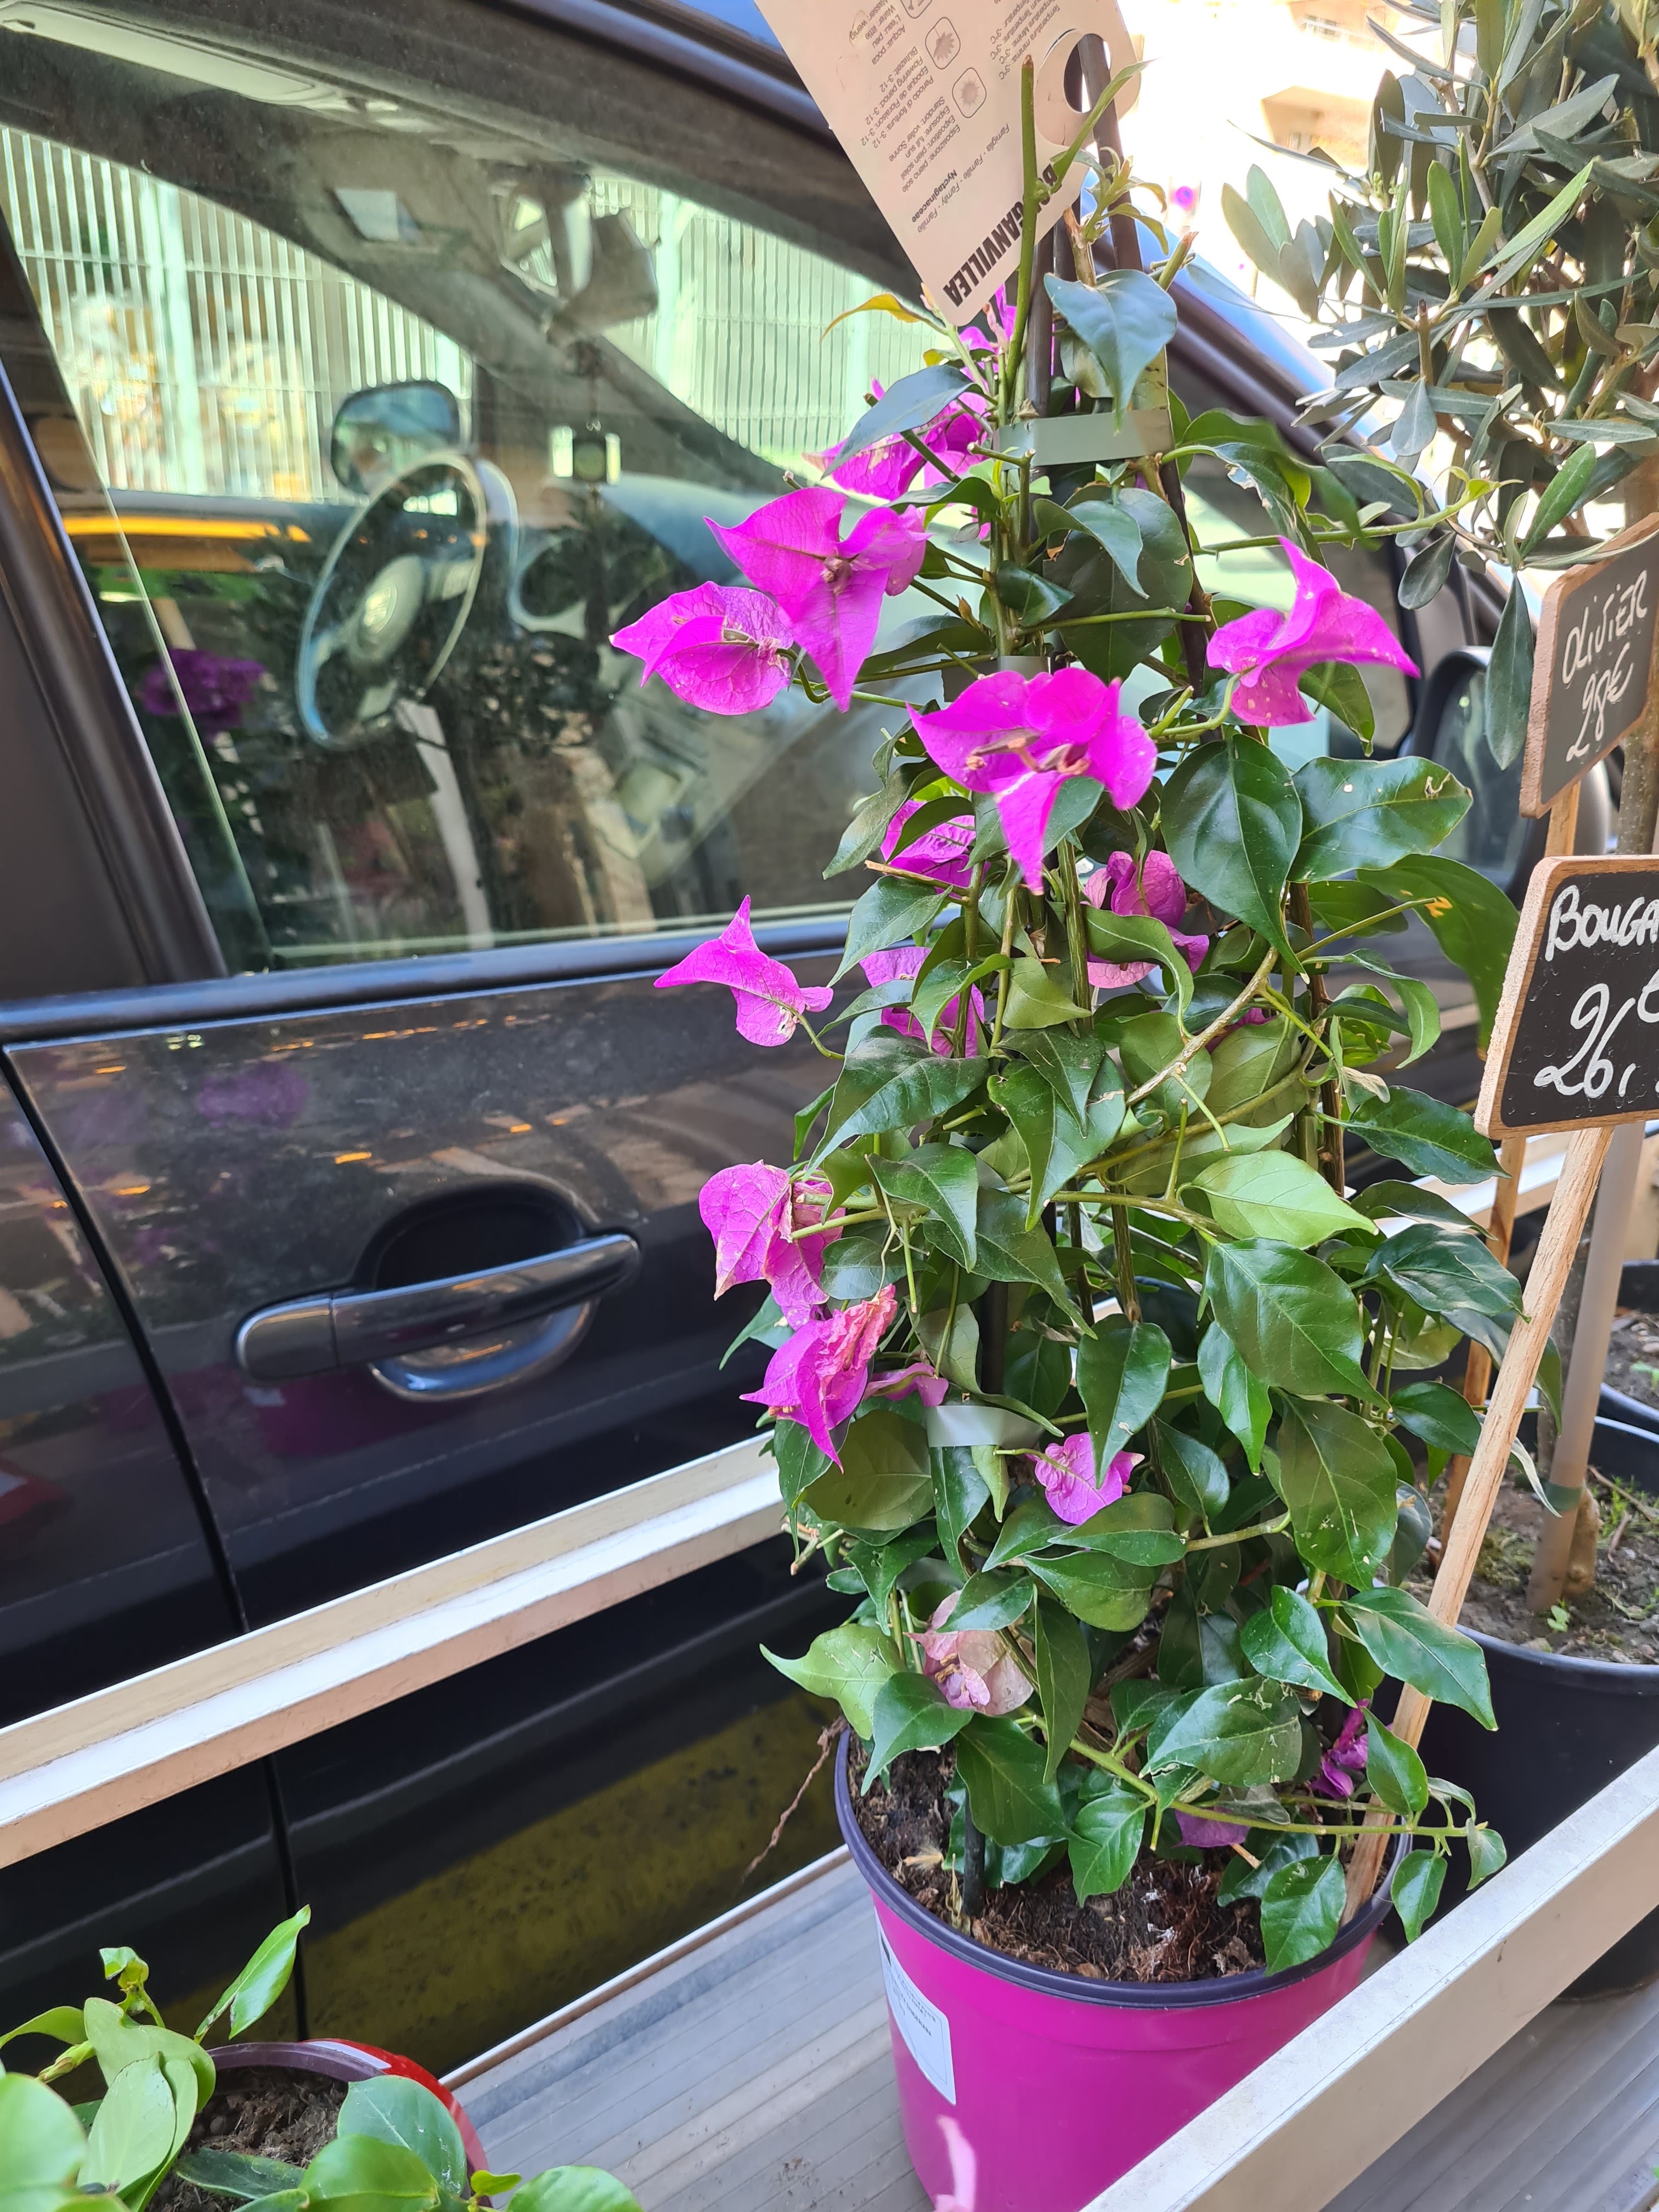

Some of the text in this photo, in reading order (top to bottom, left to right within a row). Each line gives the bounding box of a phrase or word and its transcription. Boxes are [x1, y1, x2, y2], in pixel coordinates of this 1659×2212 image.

[849, 19, 868, 41] wenig
[865, 4, 896, 40] Water: little
[871, 24, 906, 65] Acqua: poca
[872, 14, 901, 49] L'eau: peu
[865, 55, 924, 126] Flowering period: 3-12
[879, 46, 918, 93] Blütezeit: 3-12
[860, 65, 929, 146] Epoque de Floraison: 3-12
[872, 75, 934, 149] Periodo di fioritura: 3-12
[888, 96, 945, 162] Standort: voller Sonne
[905, 105, 951, 159] Exposure: full sun
[900, 115, 956, 181] Exposition: plein soleil
[901, 123, 961, 193] Esposizione: pieno sole
[986, 123, 1010, 152] Famiglia
[911, 169, 957, 223] Nyctaginaceae
[941, 182, 960, 206] Family
[943, 163, 1062, 308] BGANVILLEA
[1534, 983, 1659, 1098] 26,
